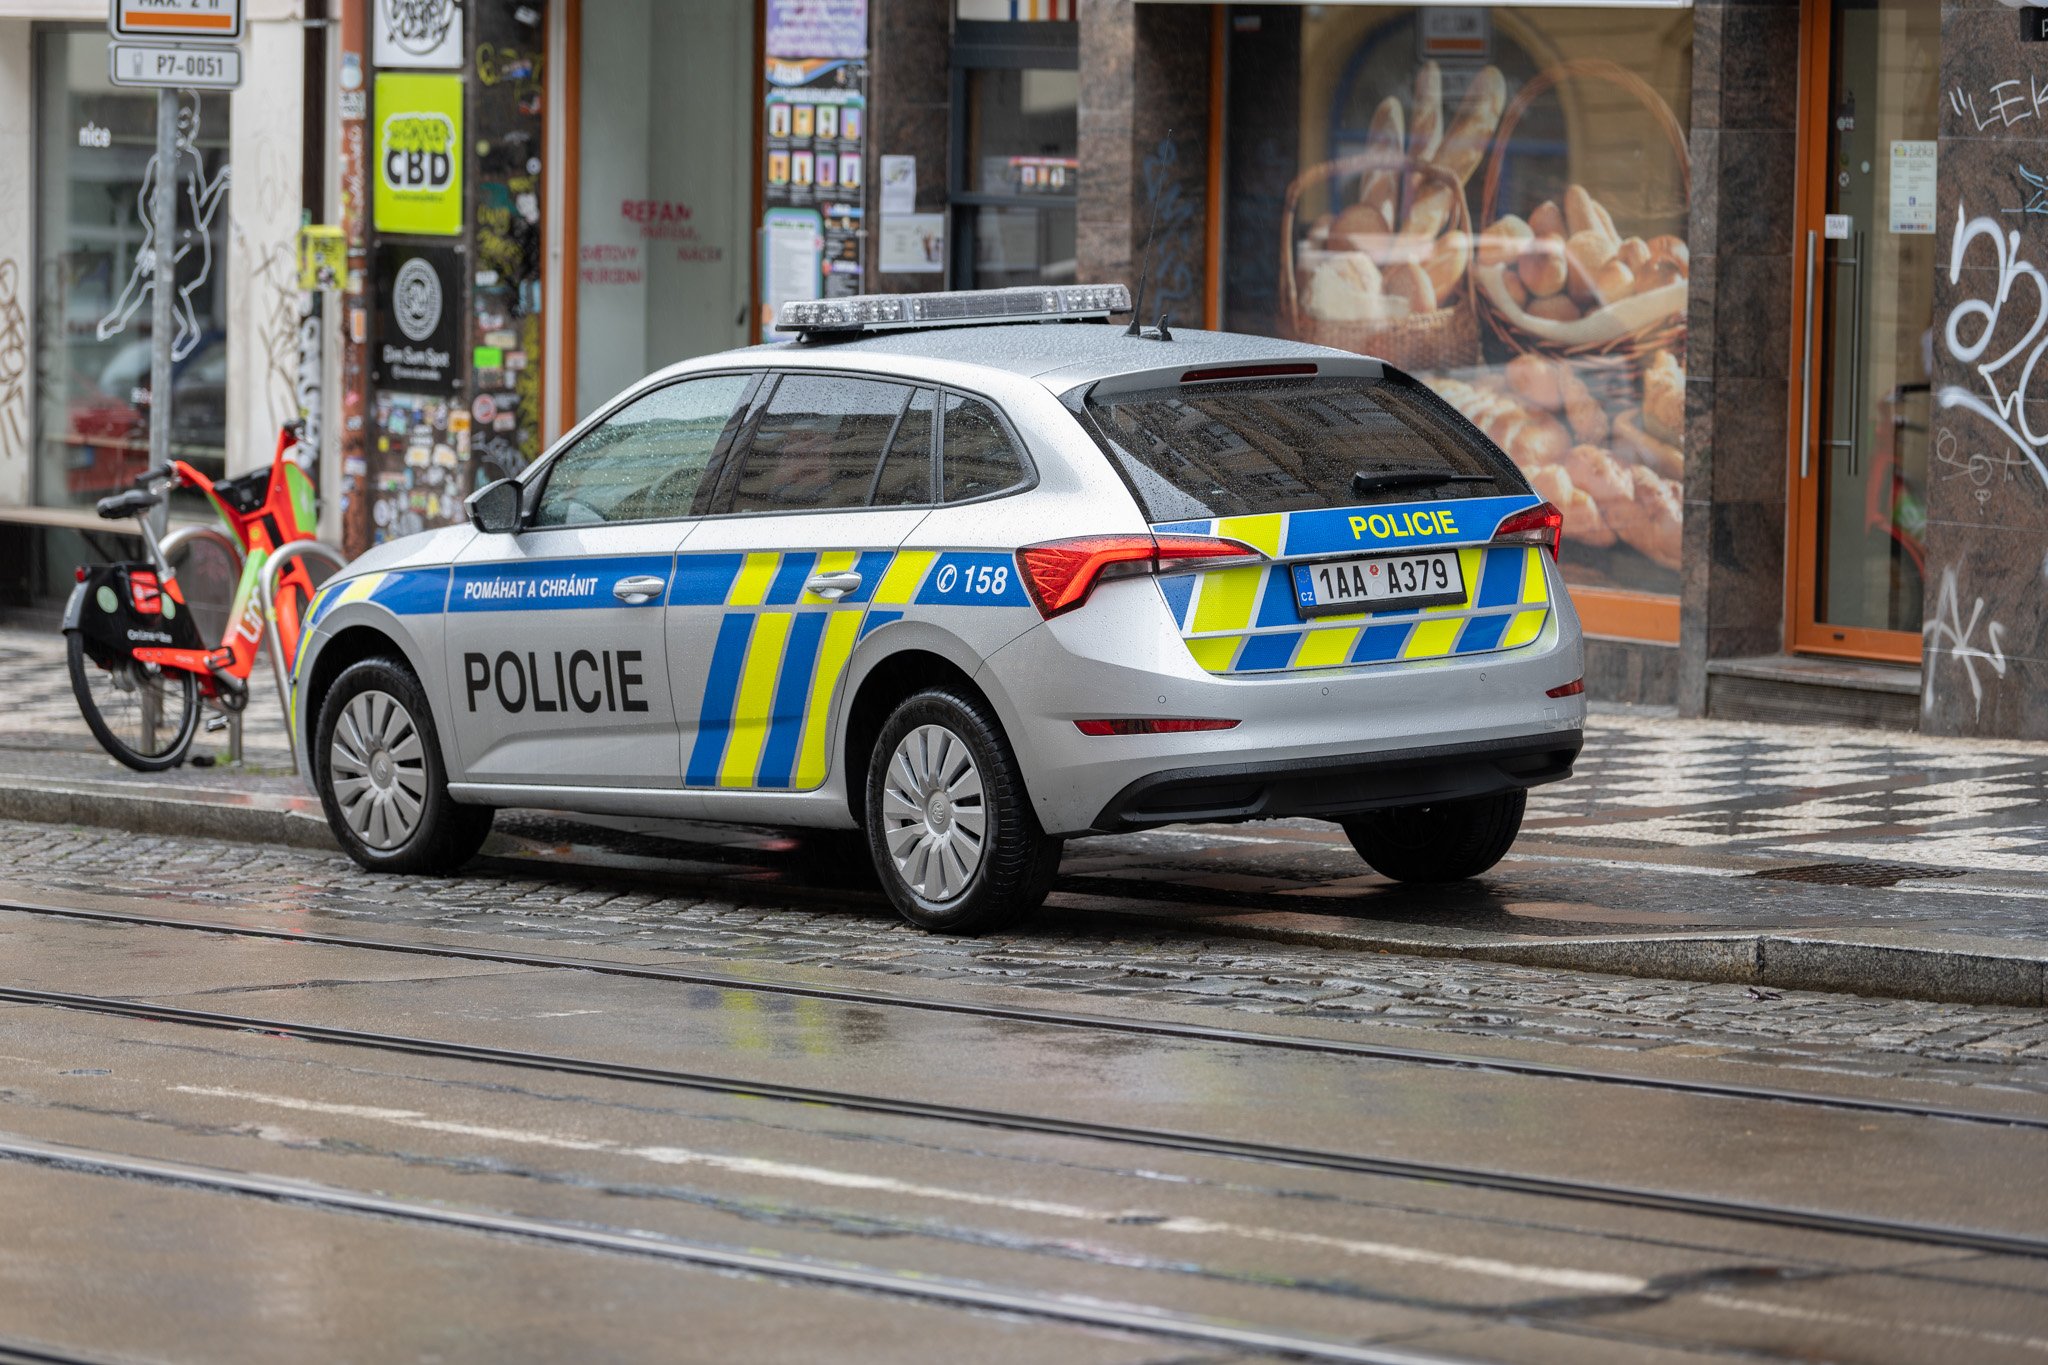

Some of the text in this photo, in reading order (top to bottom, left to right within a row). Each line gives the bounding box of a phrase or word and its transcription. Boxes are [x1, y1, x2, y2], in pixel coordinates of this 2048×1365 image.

[157, 55, 223, 77] P7-0051
[79, 120, 111, 148] nice
[387, 149, 450, 185] CBD
[383, 344, 450, 368] Dim Sum Spot
[1348, 510, 1459, 540] POLICIE
[464, 574, 598, 600] POMÁHAT A CHRÁNIT
[964, 565, 1009, 595] 158
[1319, 558, 1449, 599] 1AA A379
[1301, 592, 1314, 602] CZ
[236, 586, 263, 644] Lim
[464, 650, 649, 713] POLICIE
